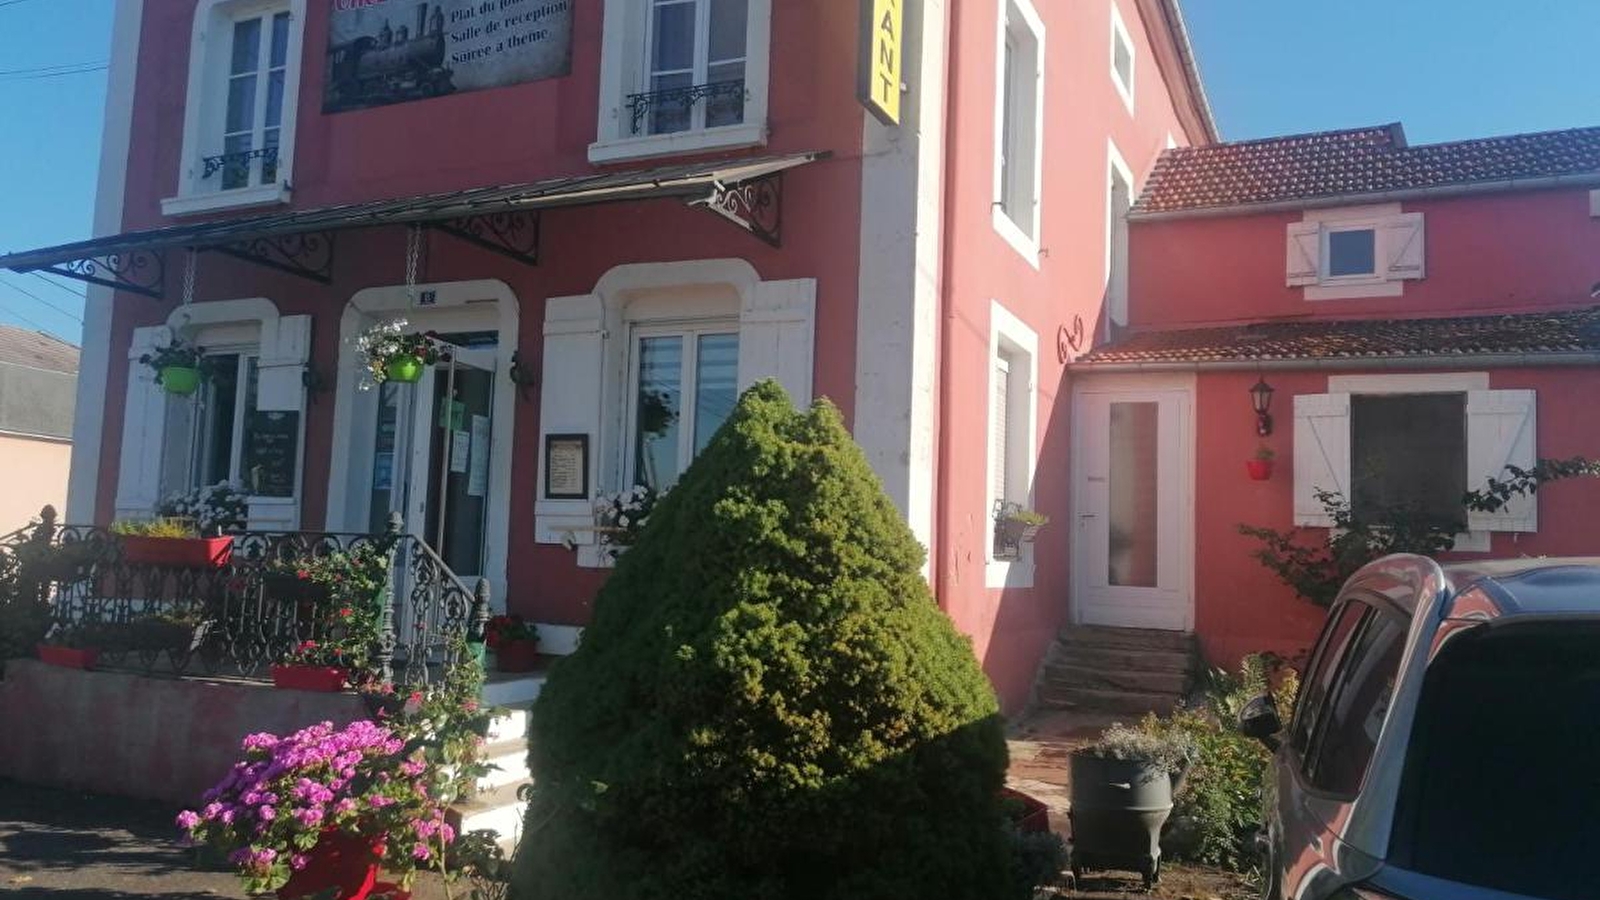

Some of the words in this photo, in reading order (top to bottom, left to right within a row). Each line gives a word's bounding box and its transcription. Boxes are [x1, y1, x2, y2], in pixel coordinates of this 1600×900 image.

[451, 7, 475, 23] Plat
[479, 1, 495, 14] du
[451, 26, 481, 43] Salle
[485, 20, 501, 33] de
[880, 0, 895, 103] ANT
